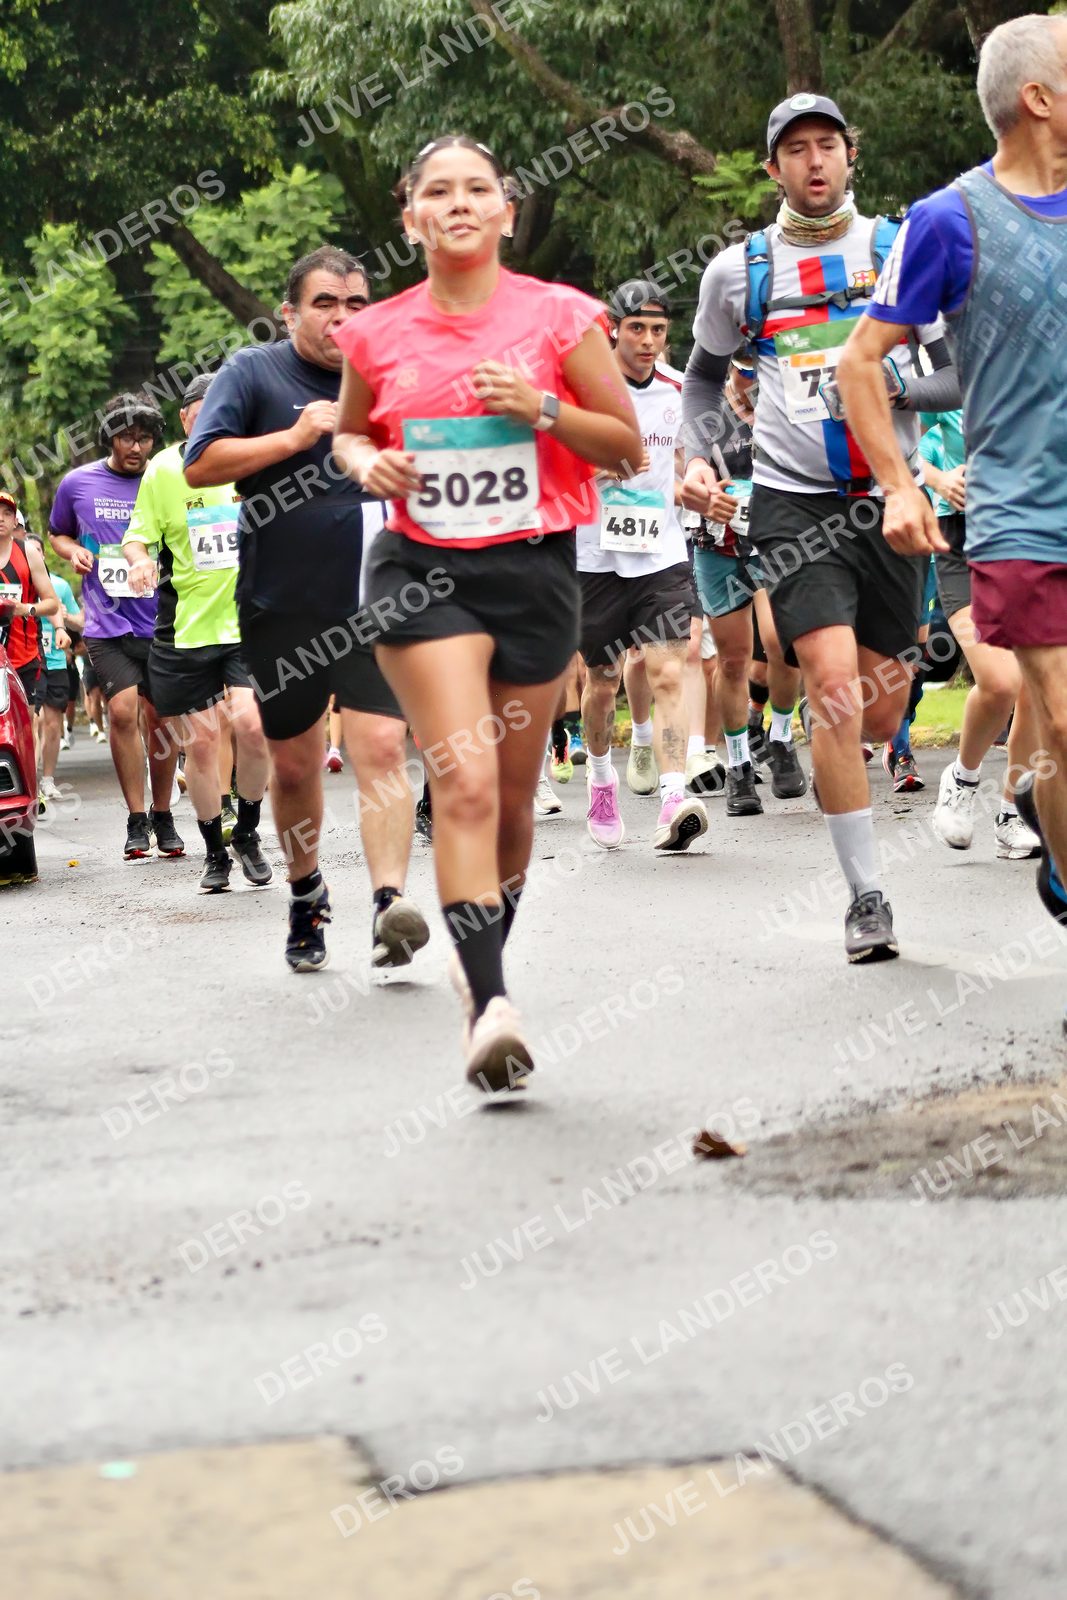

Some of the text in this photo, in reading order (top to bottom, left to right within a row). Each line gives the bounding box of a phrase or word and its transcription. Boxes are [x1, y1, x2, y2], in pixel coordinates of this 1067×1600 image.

[417, 467, 528, 508] 5028
[95, 507, 133, 520] PERD
[606, 517, 659, 538] 4814
[197, 533, 239, 555] 419
[102, 568, 128, 584] 20
